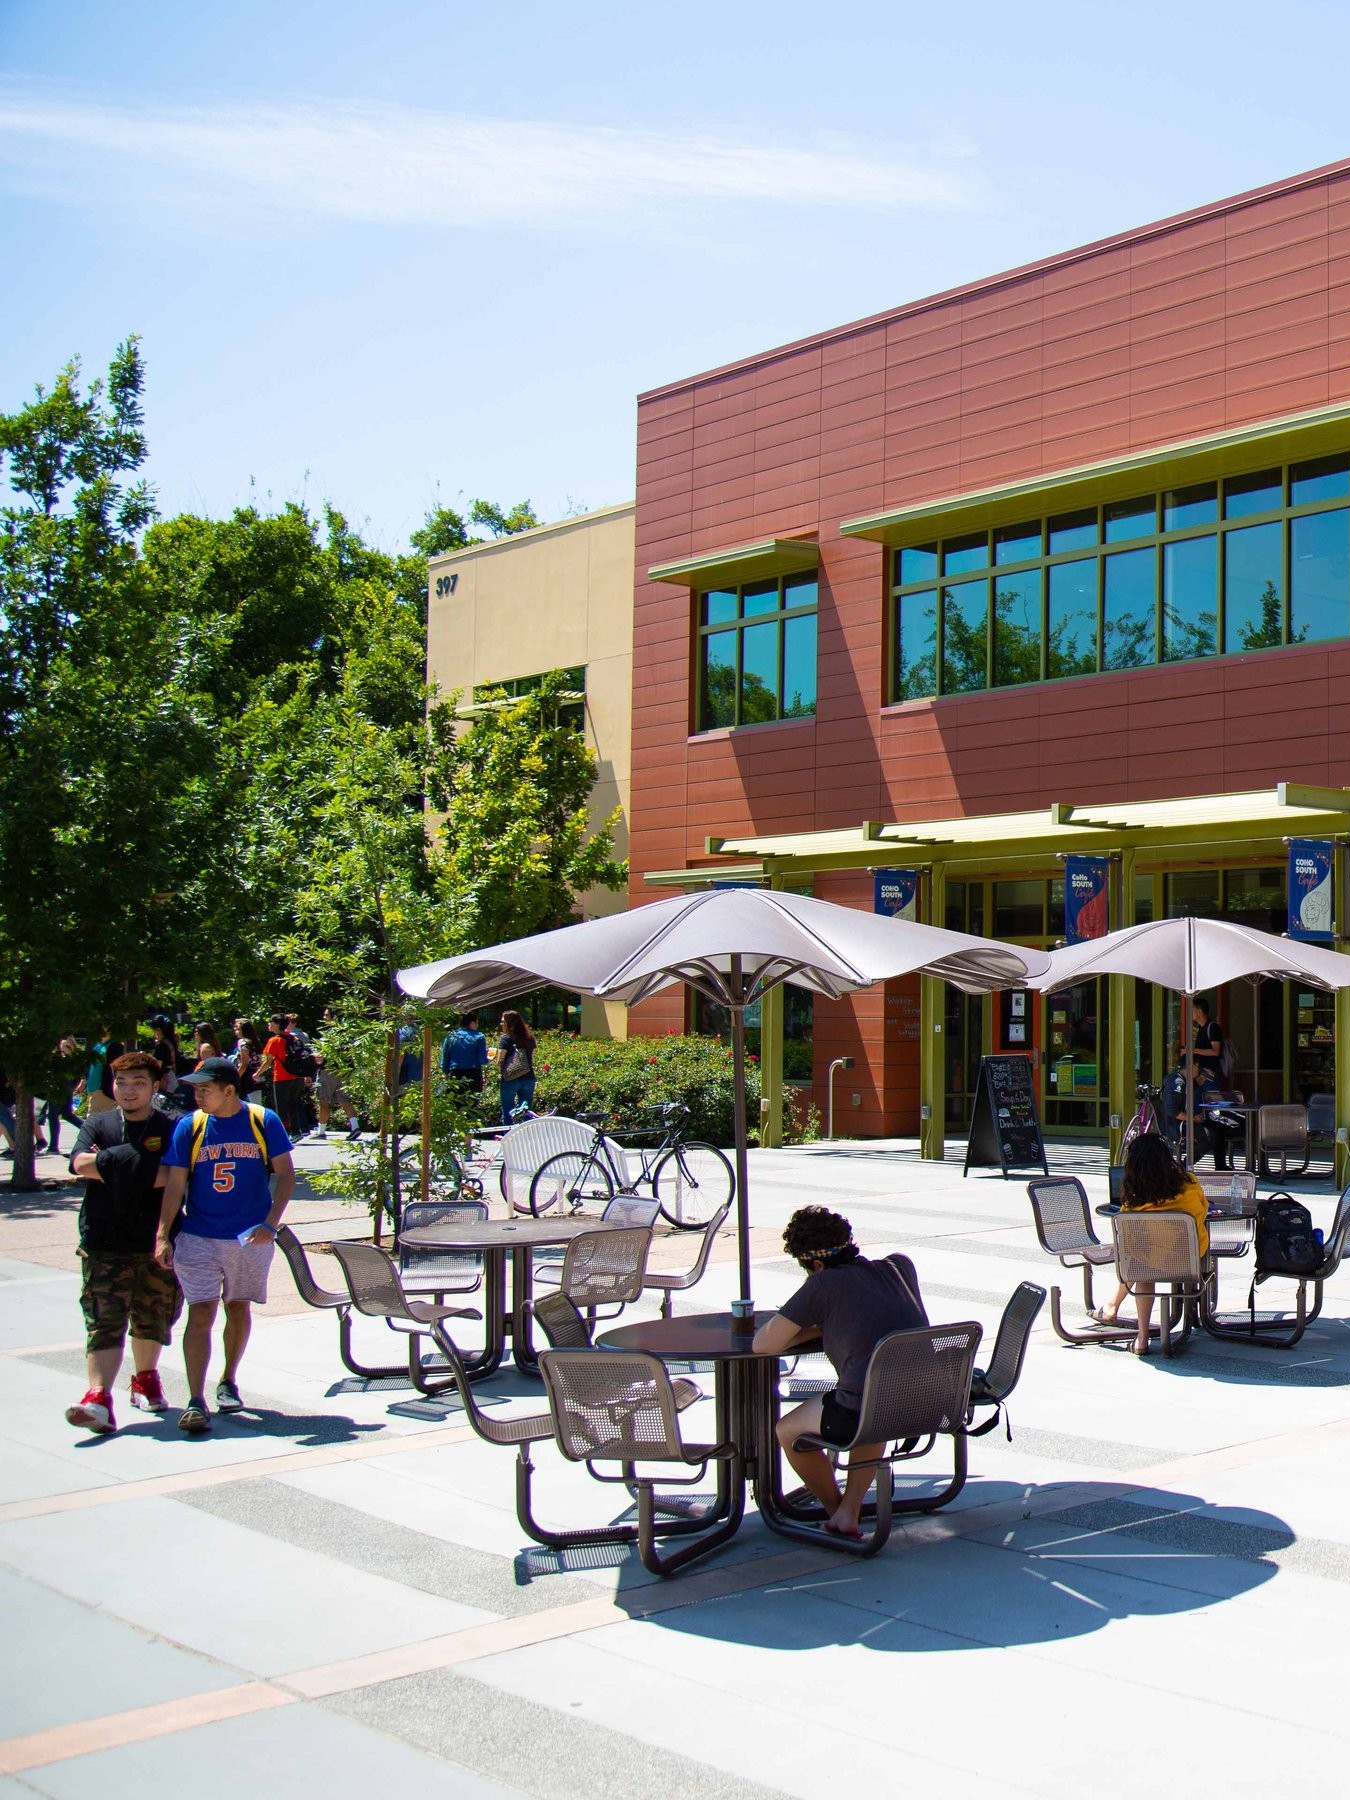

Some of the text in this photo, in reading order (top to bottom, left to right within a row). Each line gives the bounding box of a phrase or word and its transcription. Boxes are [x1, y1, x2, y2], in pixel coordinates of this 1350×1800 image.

[436, 574, 458, 597] 397
[1296, 867, 1317, 875] SOUTH
[881, 891, 903, 899] SOUTH
[223, 1142, 261, 1159] YORK
[213, 1162, 236, 1193] 5
